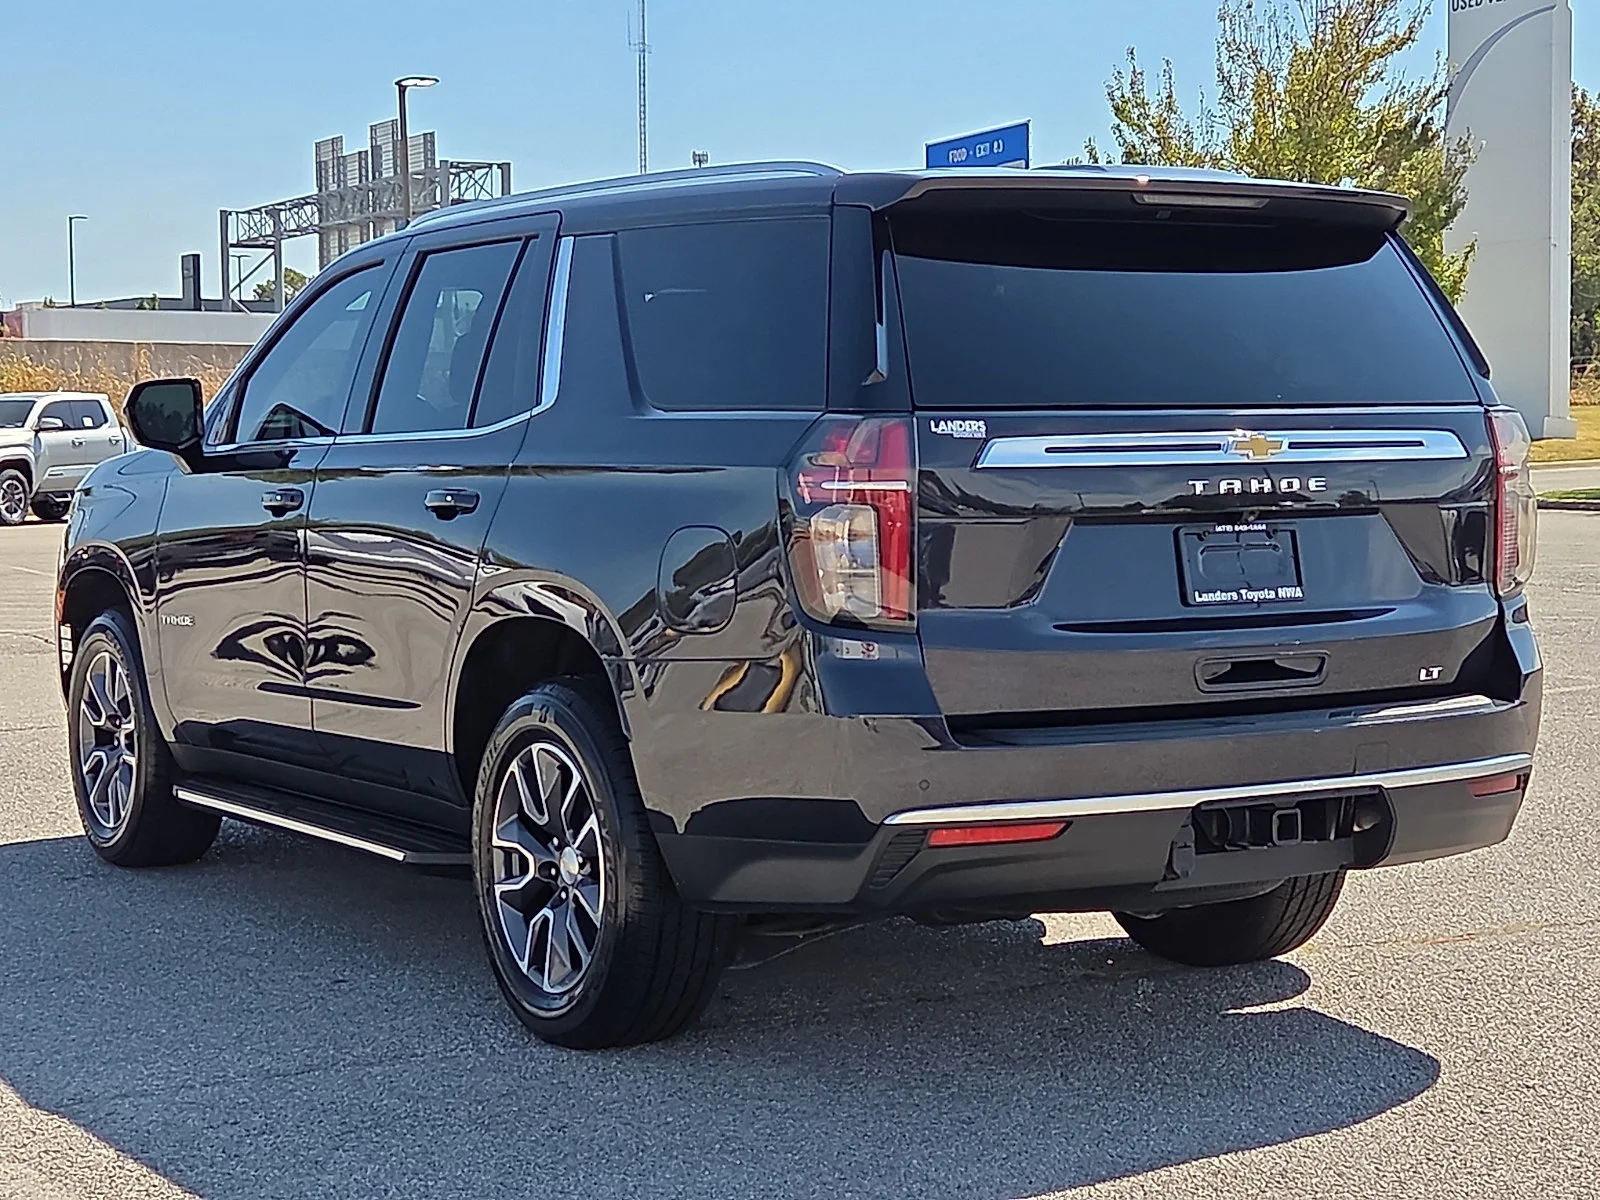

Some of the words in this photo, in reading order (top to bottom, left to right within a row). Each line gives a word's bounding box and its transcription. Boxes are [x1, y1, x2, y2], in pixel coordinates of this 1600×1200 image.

[930, 419, 987, 434] LANDERS
[1188, 477, 1327, 495] TAHOE
[1194, 590, 1238, 603] Landers
[1239, 588, 1276, 602] Toyota
[1277, 586, 1304, 599] NWA
[1419, 666, 1443, 681] LT
